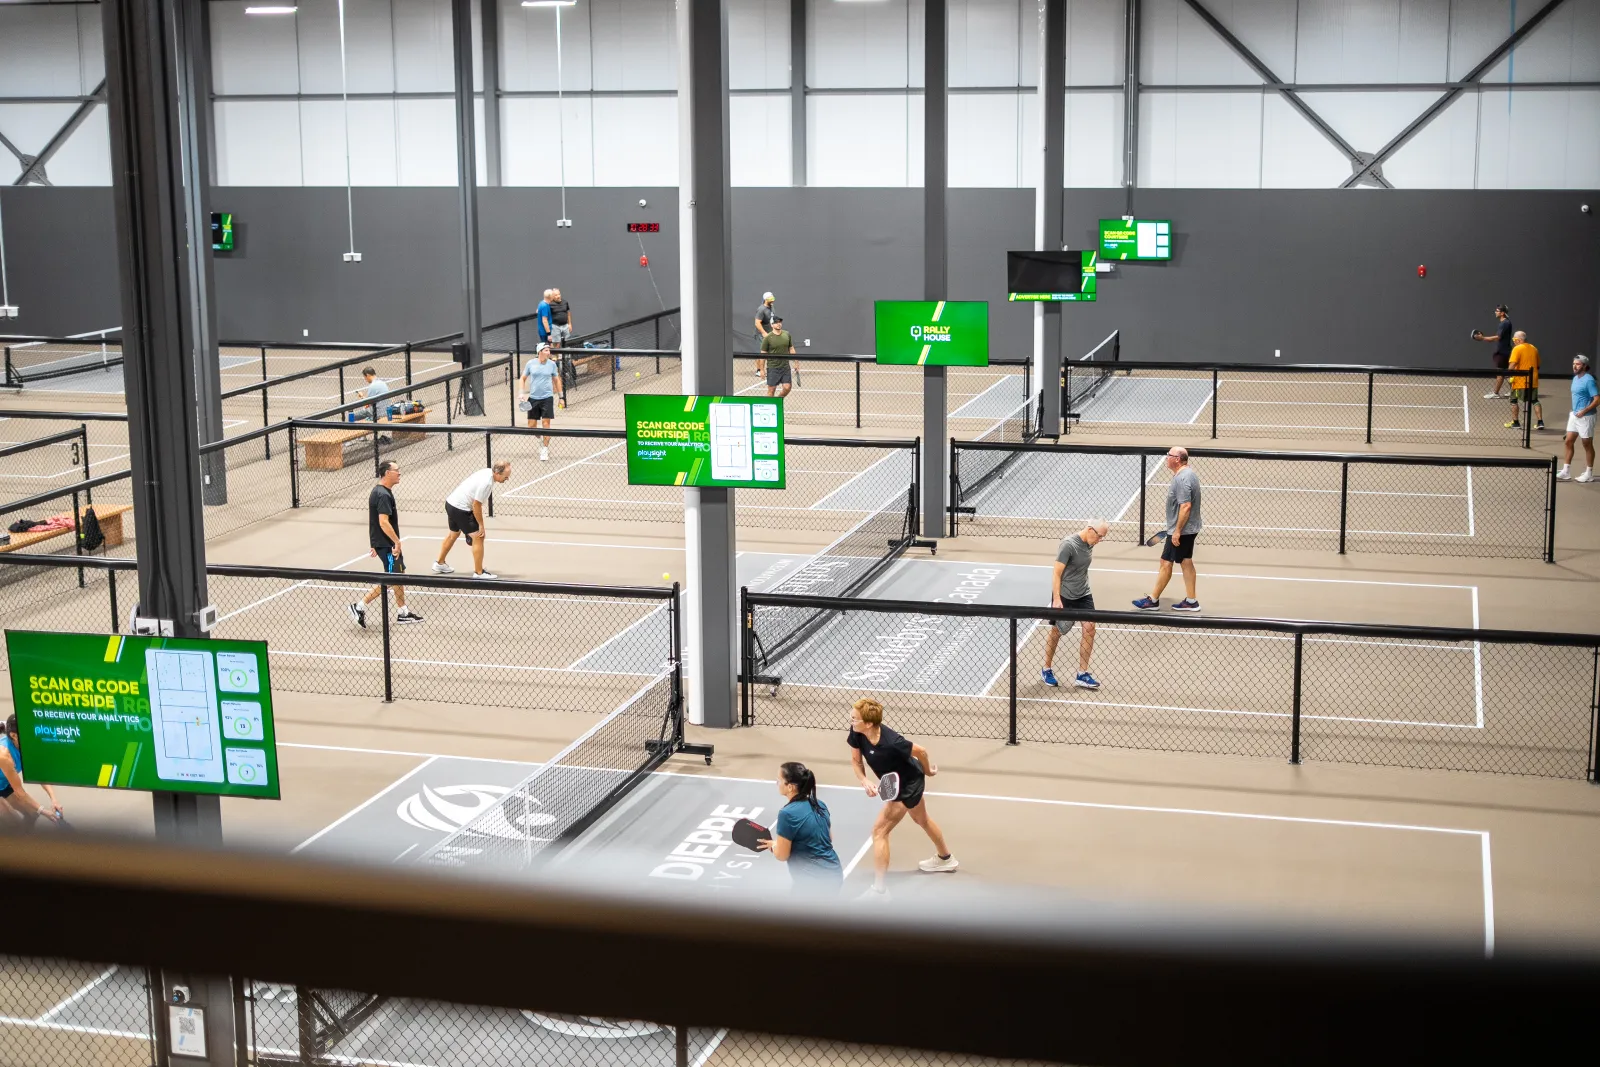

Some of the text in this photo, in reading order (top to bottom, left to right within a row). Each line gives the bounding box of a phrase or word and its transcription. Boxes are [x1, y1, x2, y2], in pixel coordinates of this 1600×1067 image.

[923, 326, 950, 334] RALLY
[637, 421, 704, 430] SCAN QR CODE
[637, 430, 689, 439] COURTSIDE
[72, 443, 80, 466] 3
[29, 676, 140, 695] SCAN QR CODE
[31, 691, 115, 708] COURTSIDE
[33, 709, 140, 723] TO RECEIVE YOUR ANALYTICS
[34, 724, 81, 738] playsight
[649, 804, 765, 881] DIEPPE
